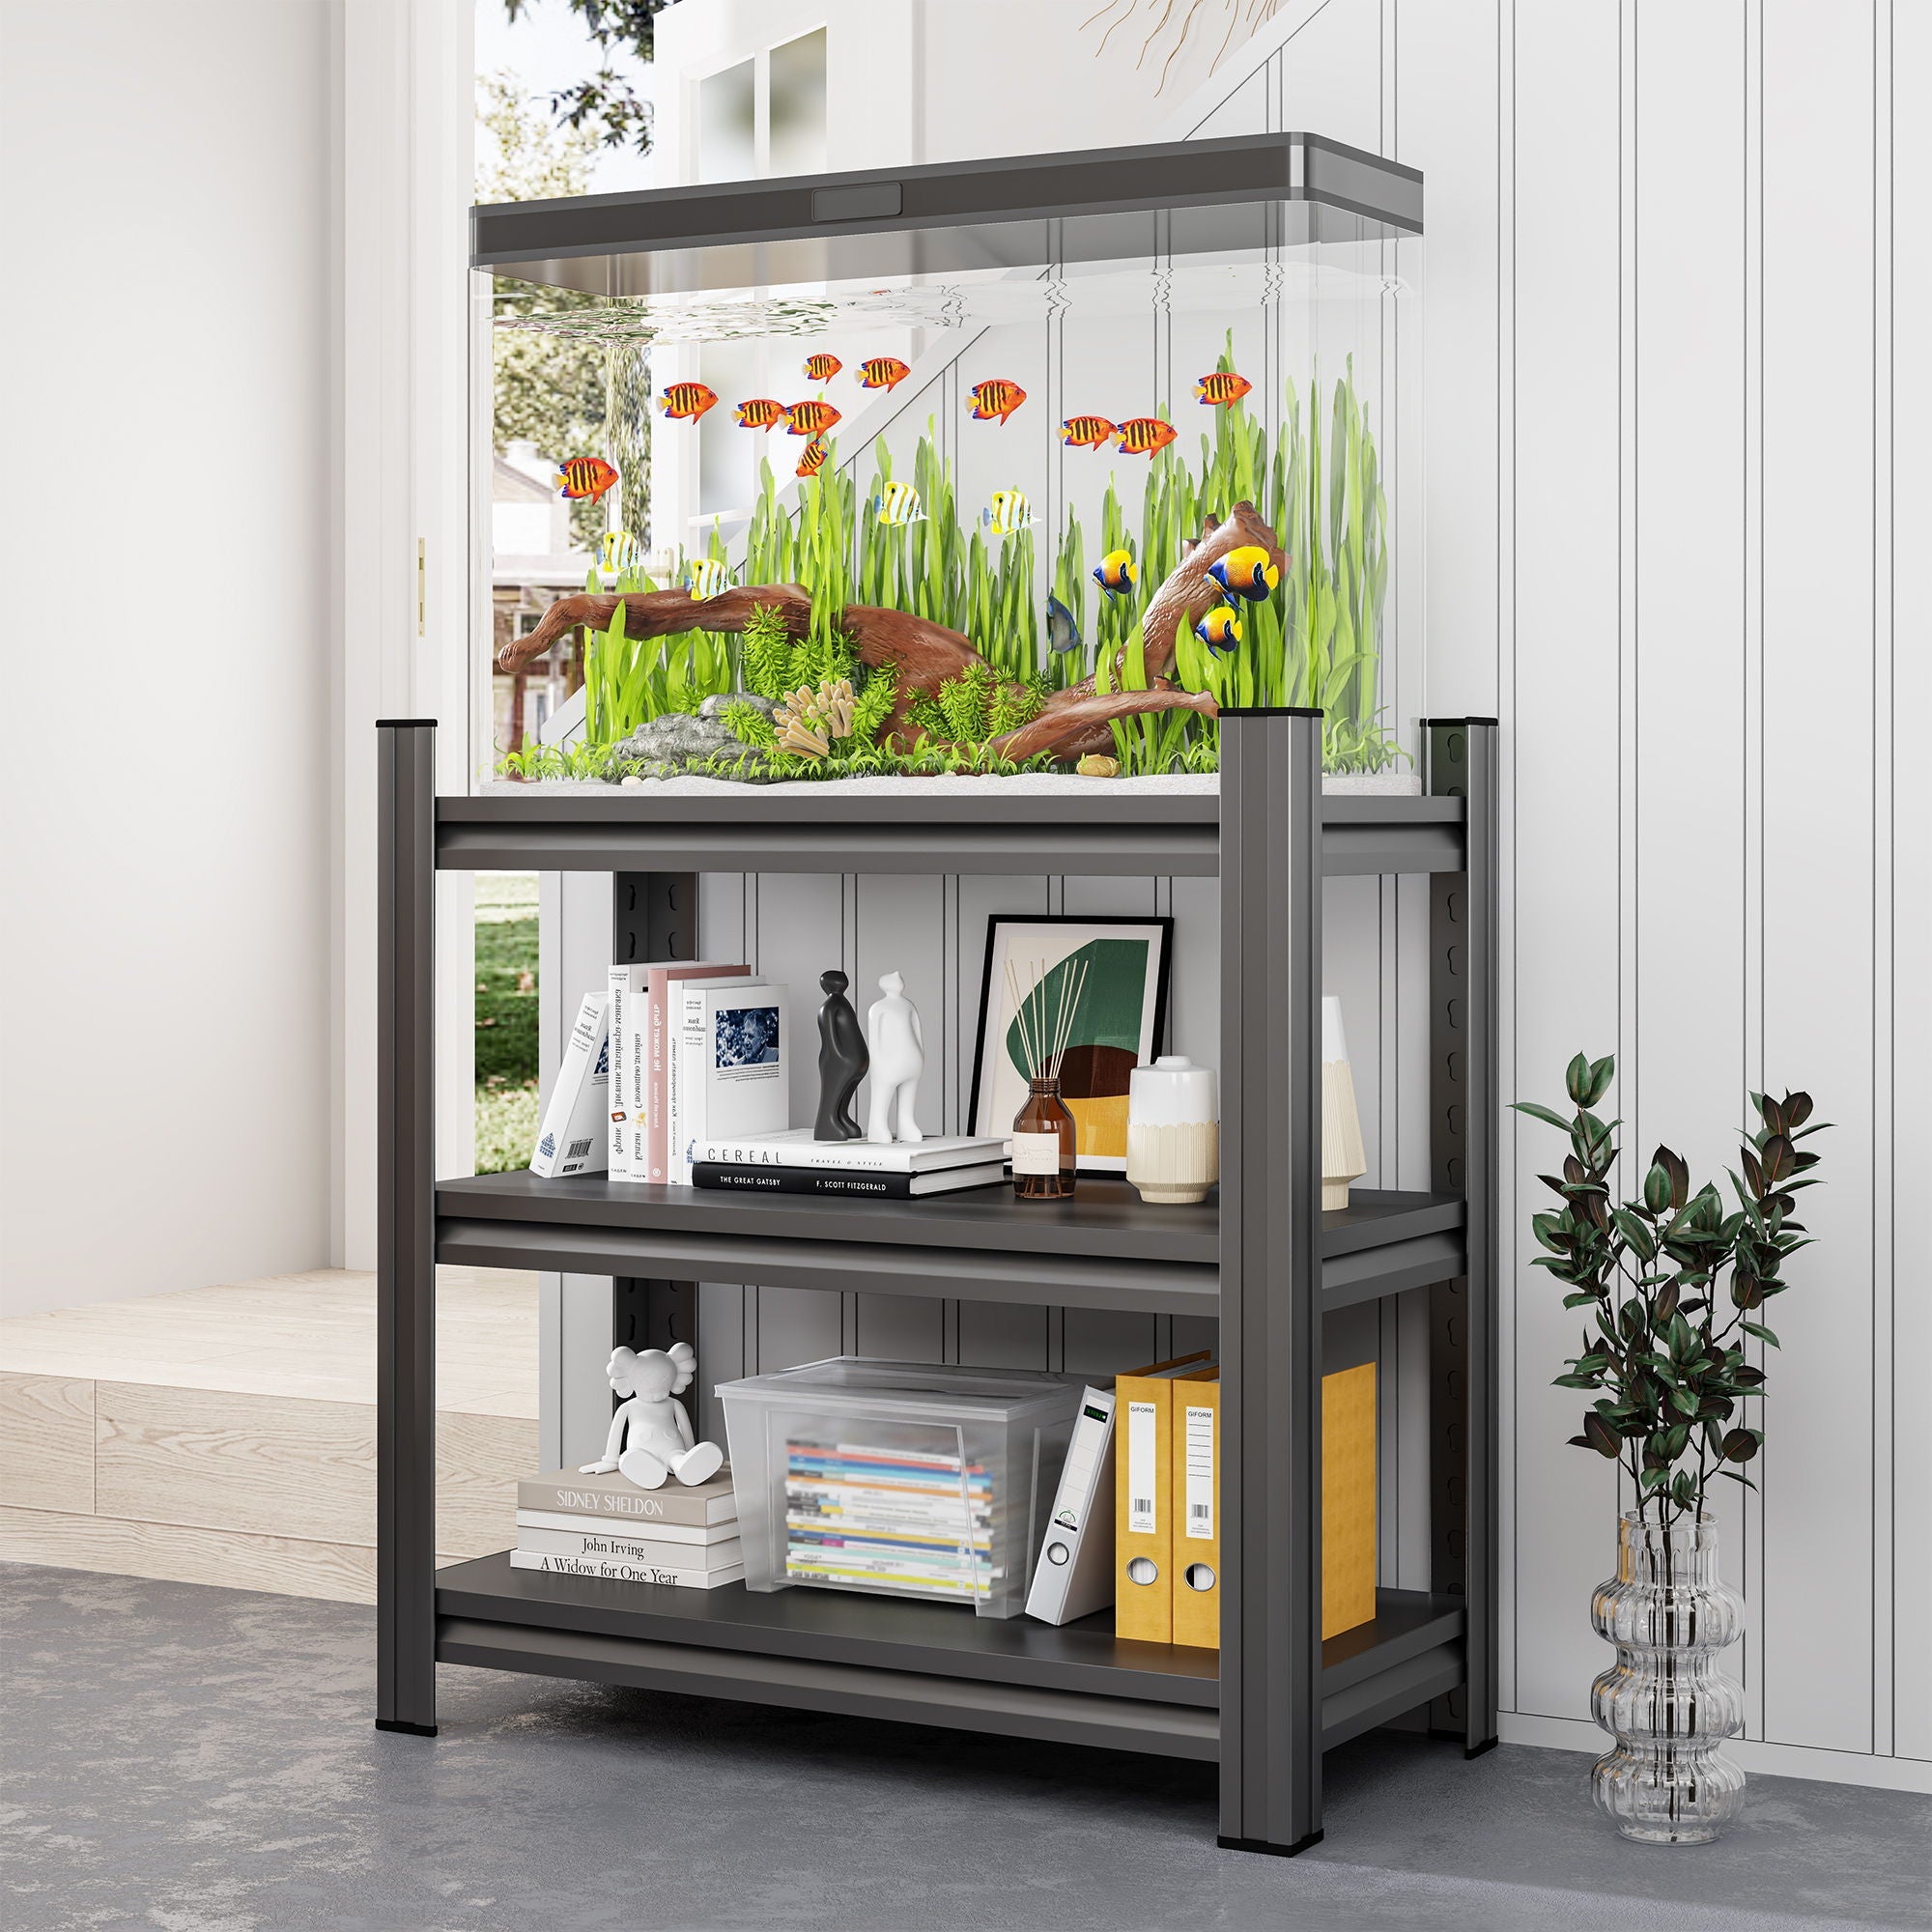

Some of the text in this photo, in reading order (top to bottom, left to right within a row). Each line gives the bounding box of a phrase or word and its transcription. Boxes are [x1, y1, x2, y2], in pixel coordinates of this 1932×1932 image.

[708, 1148, 781, 1164] CEREAL
[734, 1177, 754, 1185] GREAT
[755, 1178, 781, 1186] GATSBY
[825, 1180, 844, 1189] SCOTT
[847, 1181, 886, 1191] FITZGERALD
[1130, 1406, 1154, 1414] GIFORM
[556, 1491, 663, 1516] SIDNEY SHELDON
[582, 1538, 644, 1559] John Irving
[540, 1557, 678, 1585] A Widow for One Year
